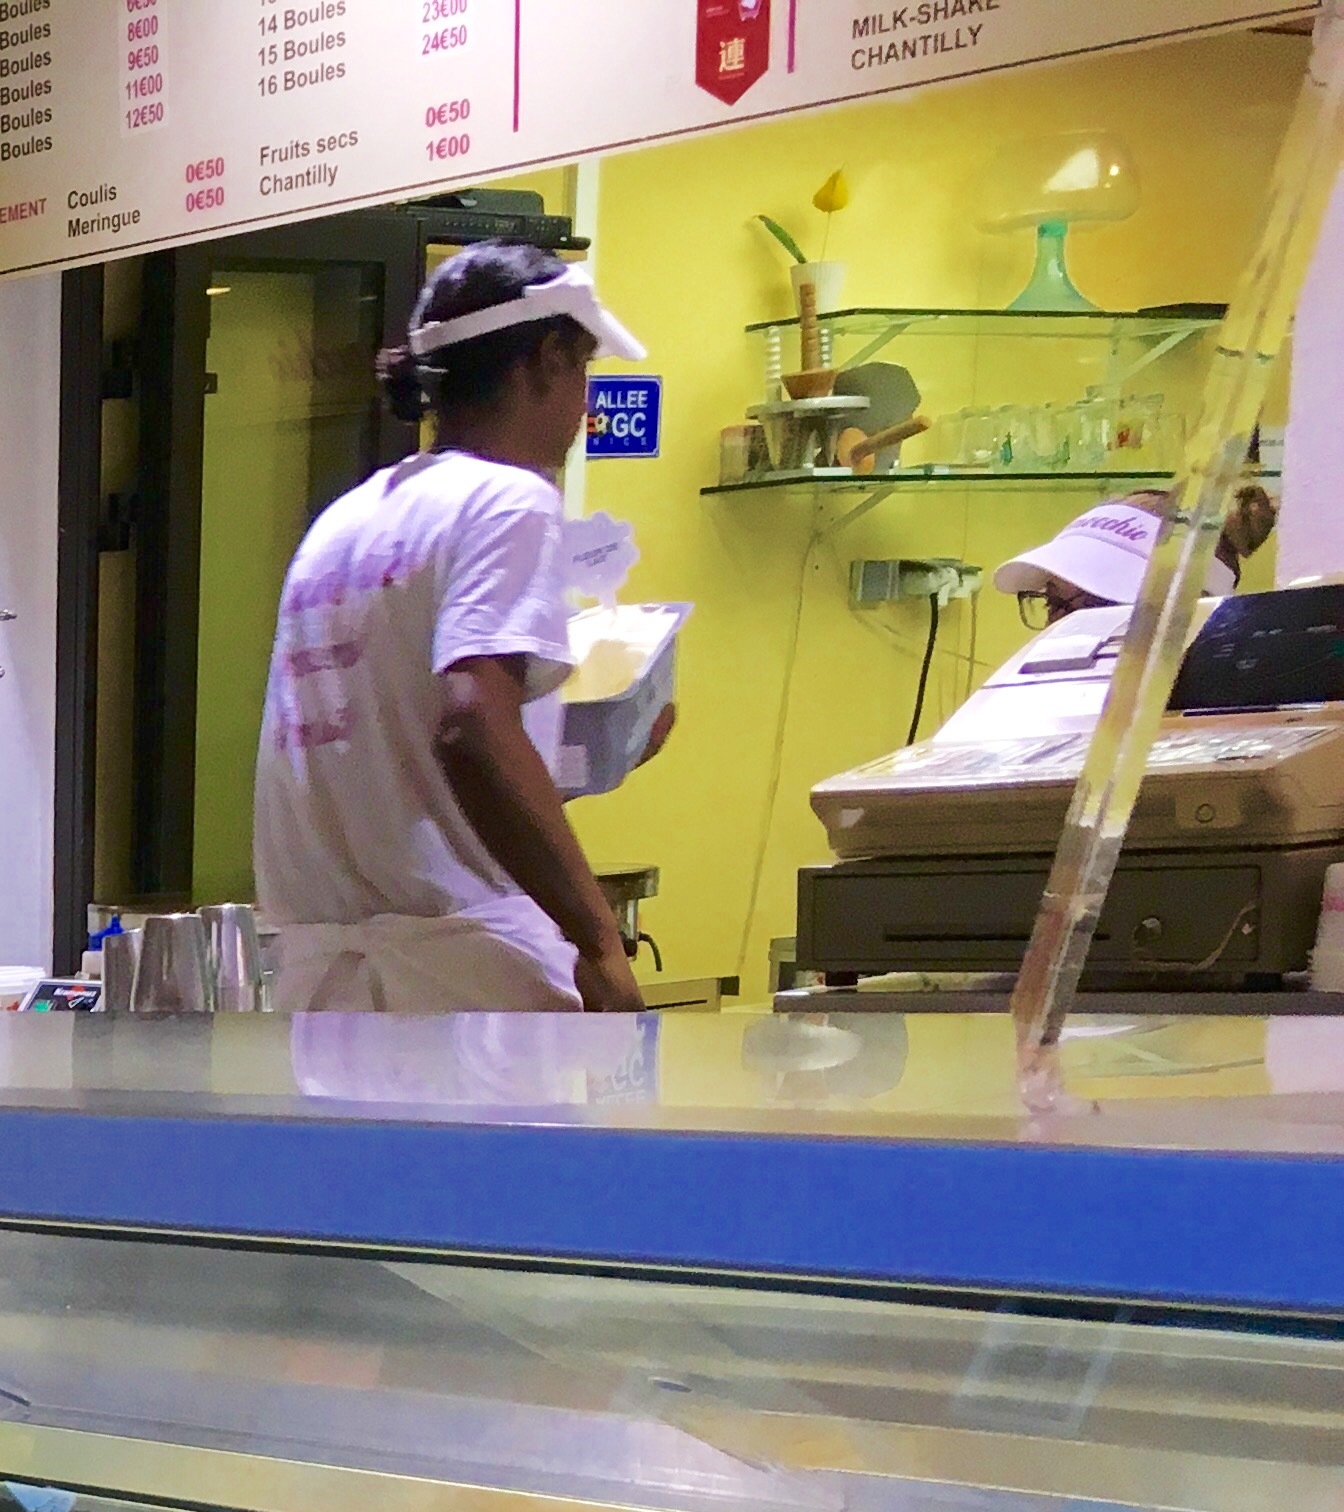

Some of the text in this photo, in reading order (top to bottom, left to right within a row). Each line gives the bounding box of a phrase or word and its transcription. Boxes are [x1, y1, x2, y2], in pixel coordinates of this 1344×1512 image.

[0, 0, 51, 23] Boules
[0, 22, 51, 50] Boules
[257, 0, 468, 56] 14 Boules 24€50
[850, 0, 1000, 40] MILK-SHAKE
[0, 51, 52, 78] Boules
[127, 15, 158, 42] 8€00
[257, 30, 346, 66] 15 Boules
[849, 23, 984, 71] CHANTILLY
[0, 79, 52, 106] Boules
[128, 44, 159, 71] 9€50
[257, 61, 346, 97] 16 Boules
[0, 107, 52, 134] Boules
[125, 72, 163, 100] 11€00
[0, 134, 53, 162] Boules
[125, 102, 164, 130] 12€50
[259, 98, 471, 167] Fruits secs 0€50
[67, 157, 225, 210] Coulis 0€50
[259, 133, 471, 196] Chantilly 1€00
[68, 186, 225, 239] Meringue 0€50
[595, 390, 649, 409] ALLEE
[1078, 516, 1149, 541] cchio
